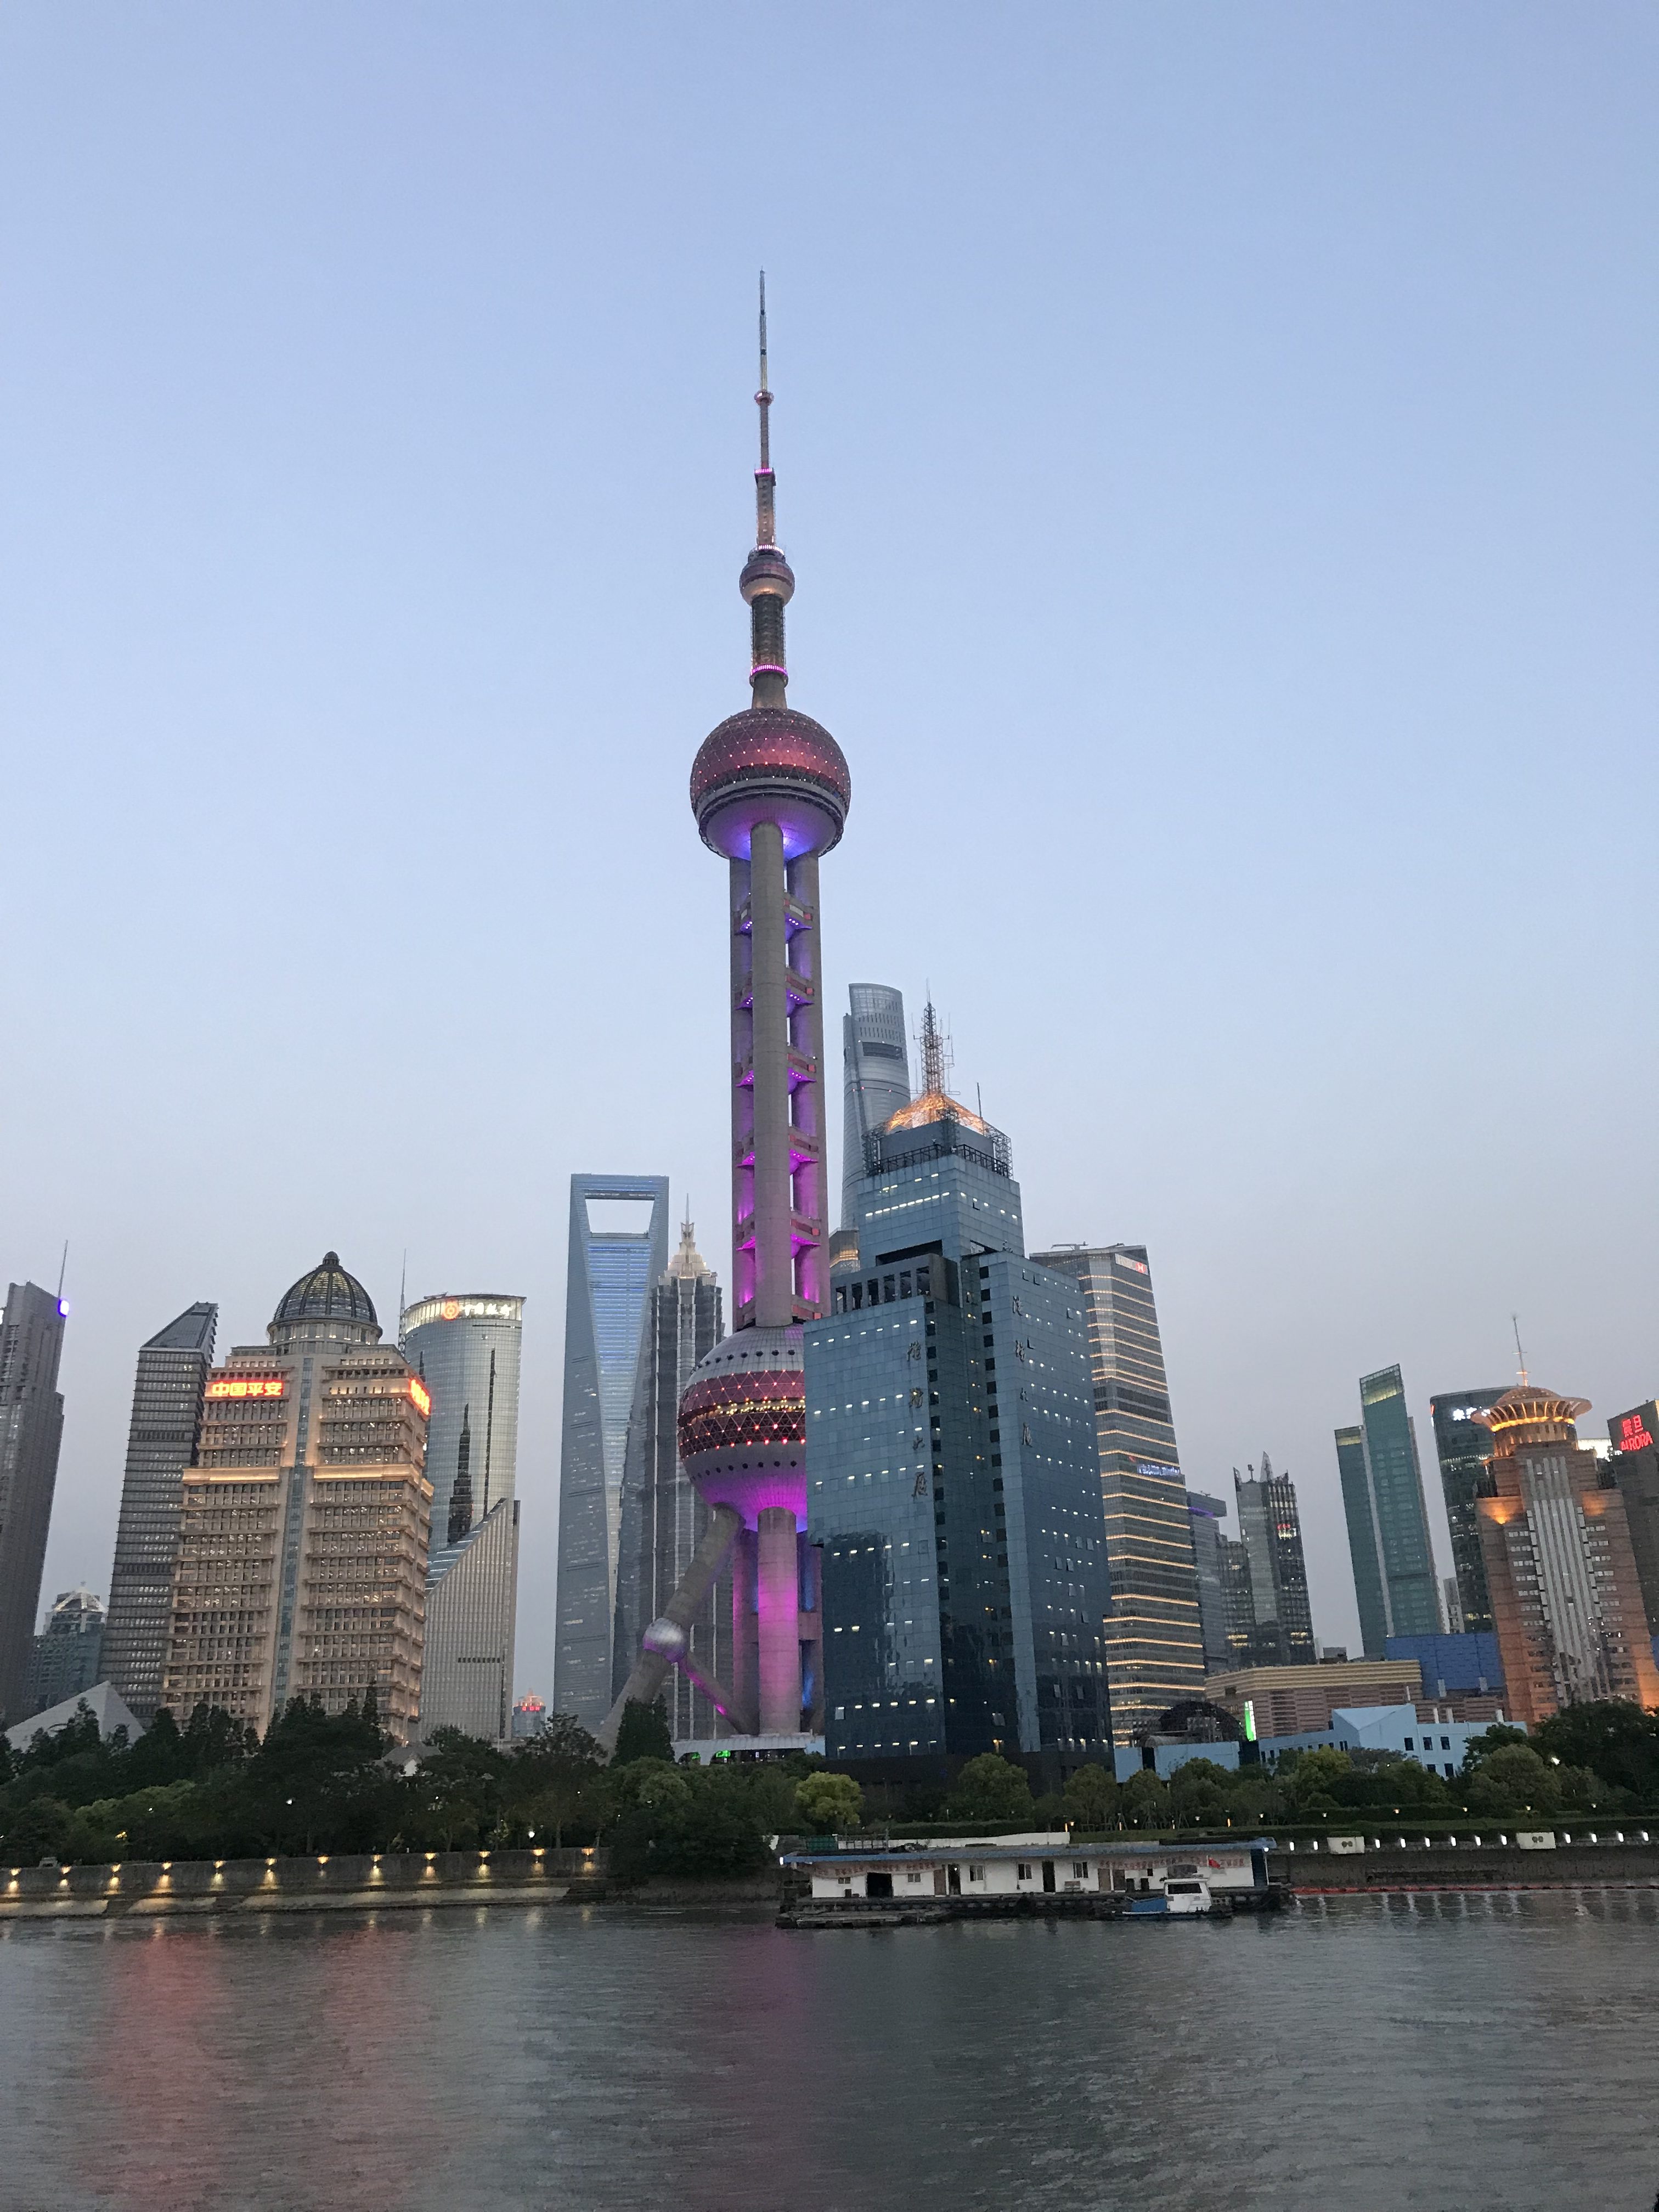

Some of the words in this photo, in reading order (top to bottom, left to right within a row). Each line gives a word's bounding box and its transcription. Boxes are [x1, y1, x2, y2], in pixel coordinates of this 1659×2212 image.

[212, 1381, 283, 1397] 中国平安
[1622, 1415, 1644, 1437] 震旦
